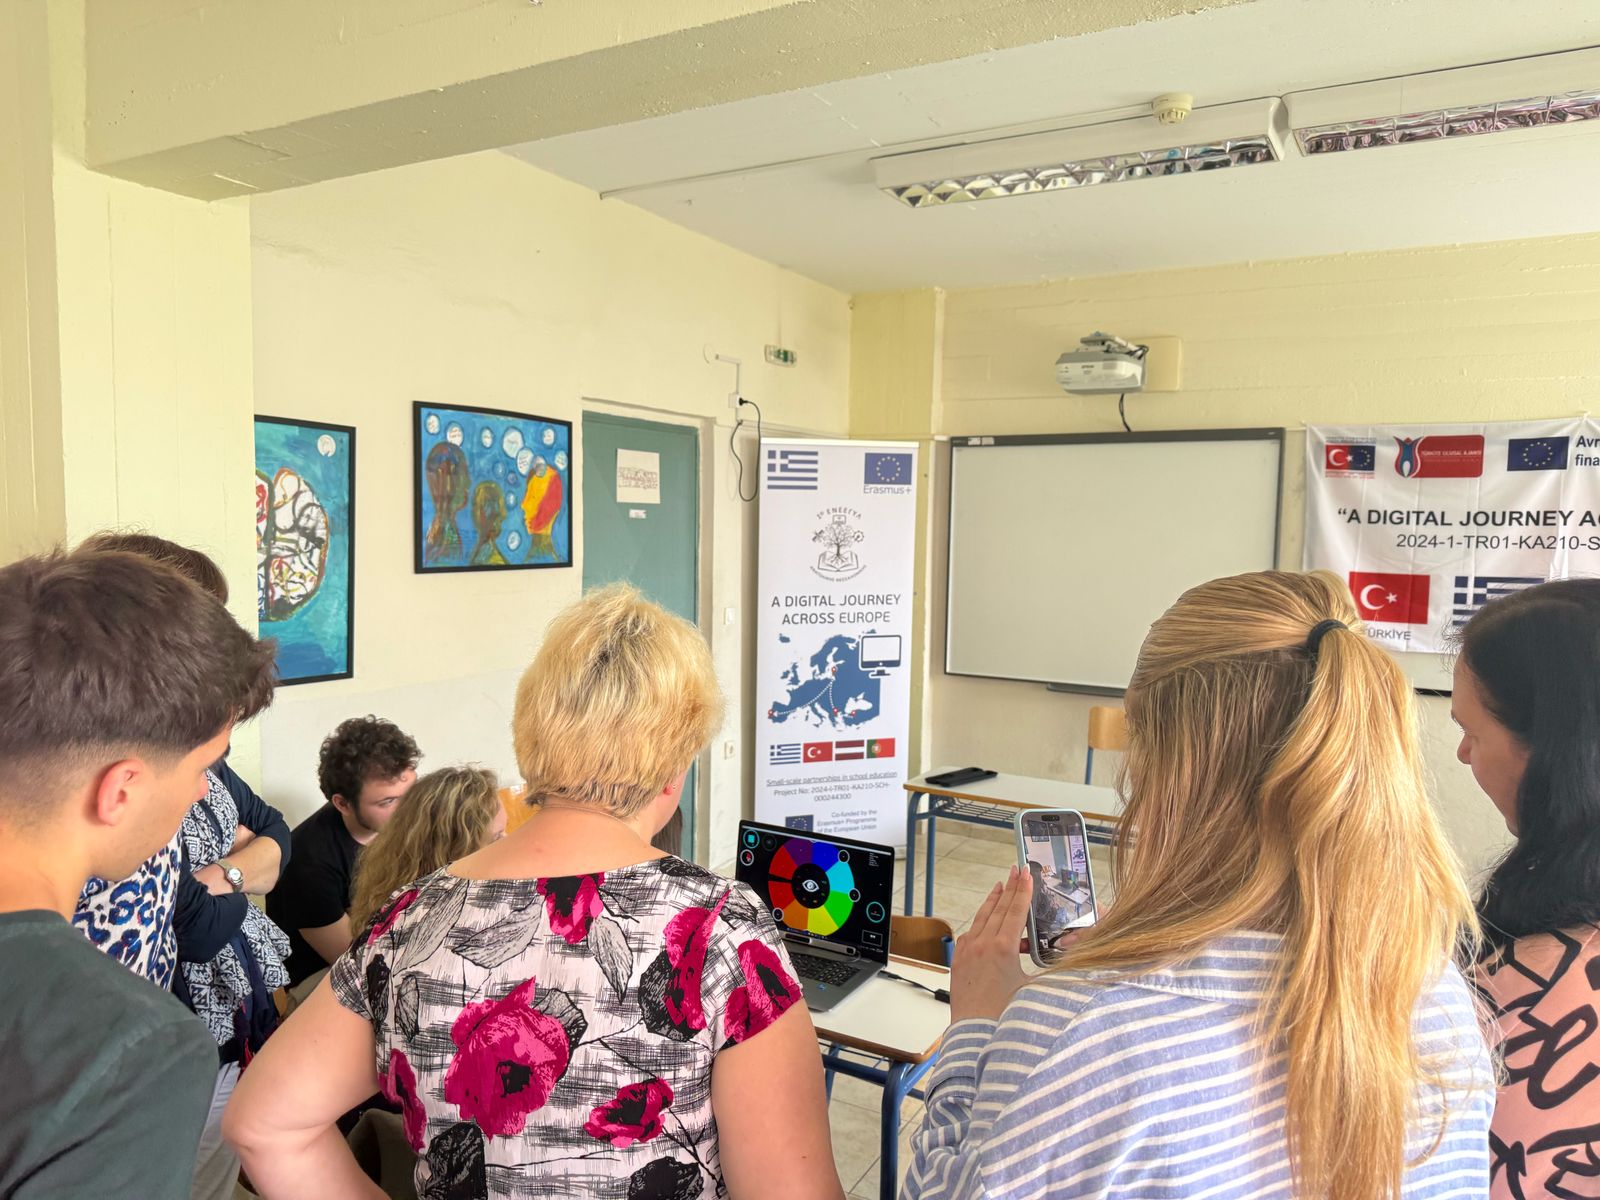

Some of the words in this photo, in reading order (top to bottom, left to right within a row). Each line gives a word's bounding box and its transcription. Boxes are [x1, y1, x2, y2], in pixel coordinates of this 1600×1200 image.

[863, 485, 912, 494] Erasmus+
[1367, 509, 1453, 526] DIGITAL
[1459, 510, 1574, 527] JOURNEY
[1579, 510, 1600, 527] A
[771, 596, 780, 607] A
[785, 595, 836, 607] DIGITAL
[839, 594, 901, 606] JOURNEY
[782, 612, 835, 625] ACROSS
[839, 611, 891, 624] EUROPE
[1364, 626, 1411, 640] ÜRKİYE
